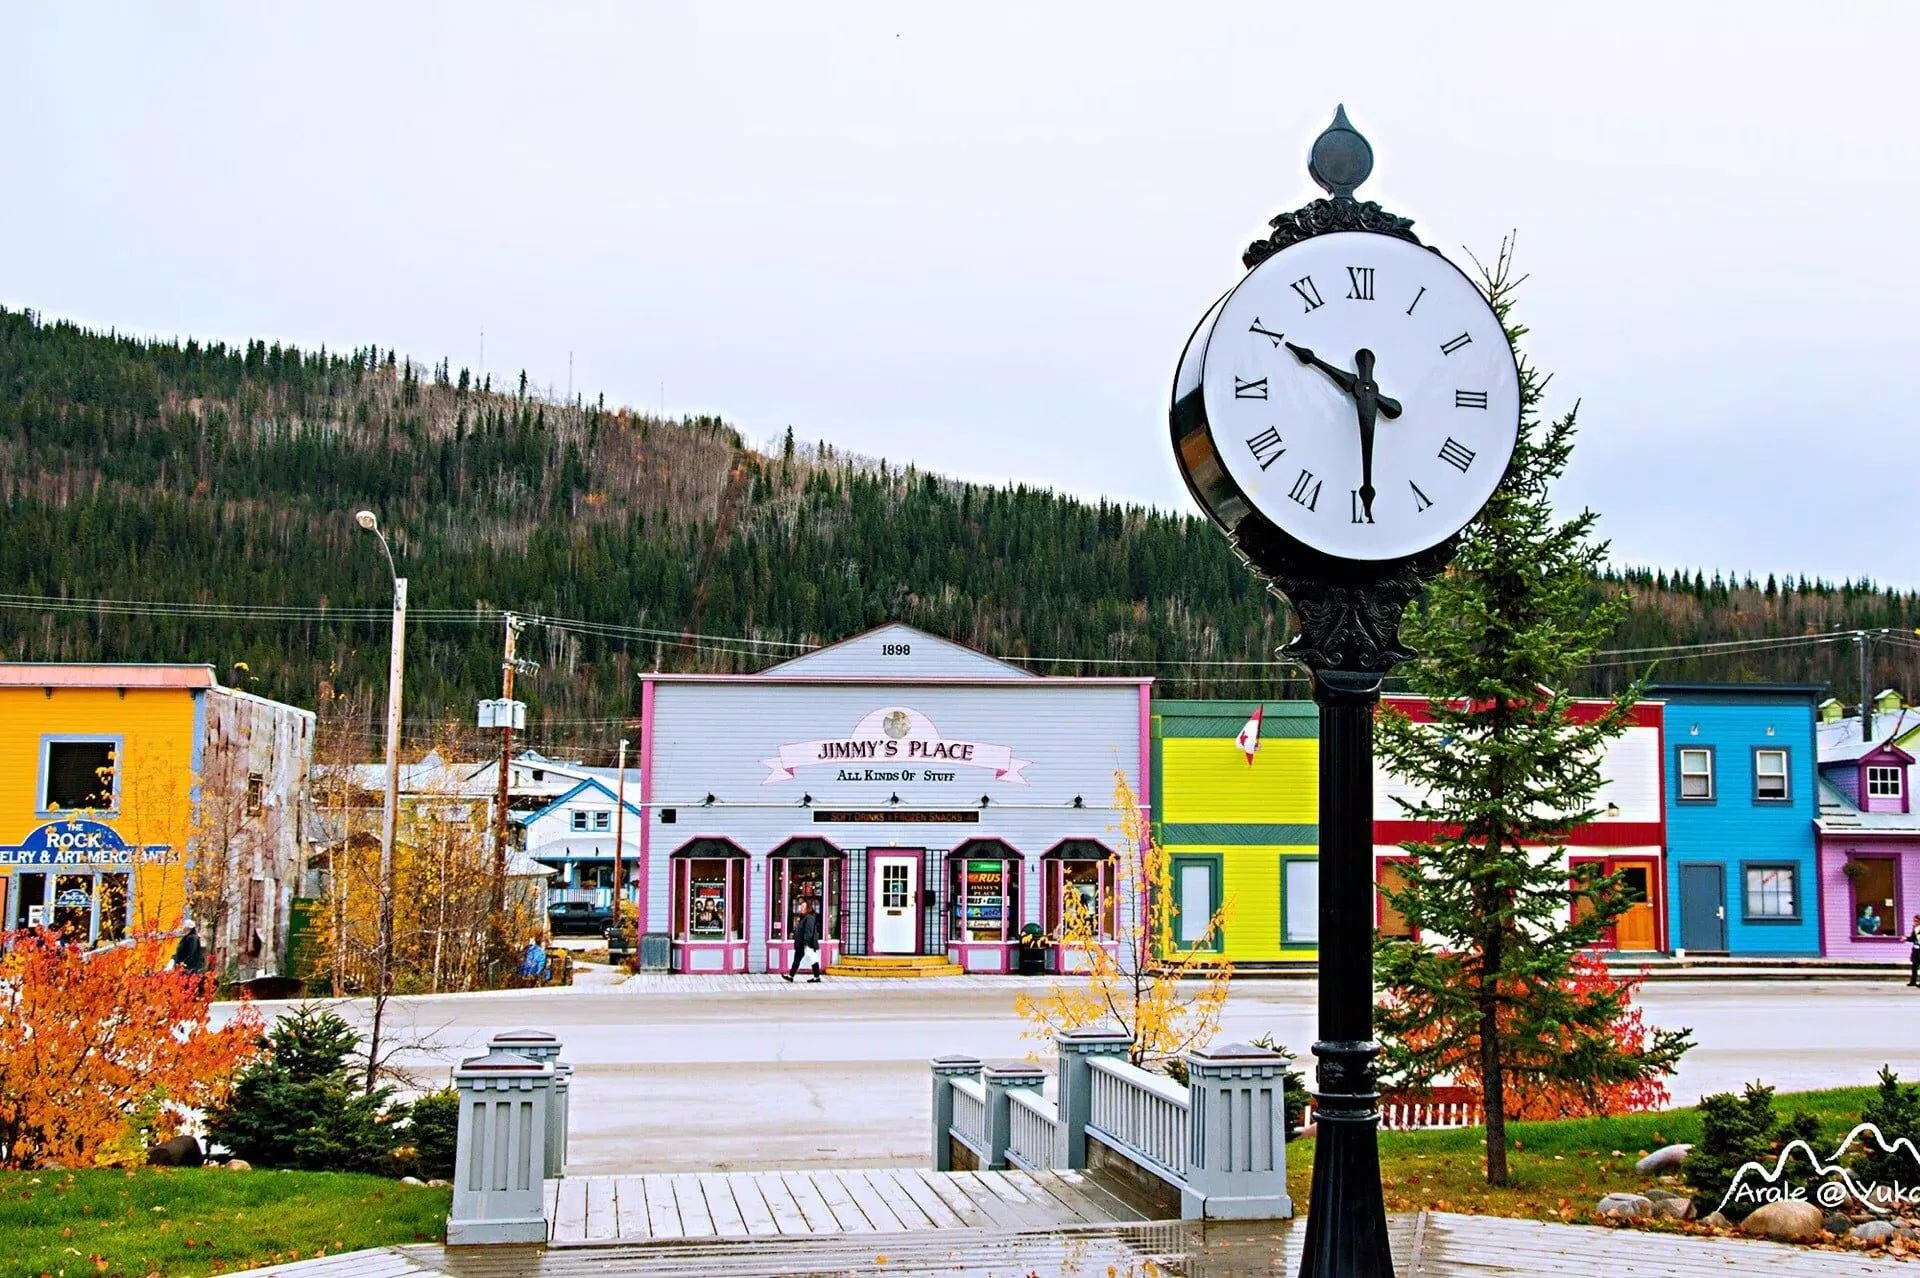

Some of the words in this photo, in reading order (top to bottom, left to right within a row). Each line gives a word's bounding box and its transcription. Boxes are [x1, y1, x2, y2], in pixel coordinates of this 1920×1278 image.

[1290, 276, 1325, 313] XI
[1346, 267, 1375, 300] XII
[1406, 287, 1426, 315] I
[1249, 317, 1284, 348] X
[1440, 332, 1472, 356] II
[1235, 376, 1267, 400] IX
[1455, 389, 1487, 410] III
[1246, 426, 1286, 471] VIII
[1438, 437, 1476, 473] IIII
[1288, 469, 1322, 512] VII
[1409, 480, 1433, 512] V
[882, 644, 911, 656] 1898
[818, 740, 898, 760] JIMMY'S
[908, 741, 974, 761] PLACE
[836, 770, 862, 782] ALL
[864, 770, 899, 782] KINDS
[924, 770, 955, 782] STUFF
[855, 813, 885, 821] DRINKS
[895, 813, 927, 821] FROZEN
[929, 813, 962, 821] SNACKS
[46, 833, 101, 848] ROCK
[40, 850, 51, 863] &
[54, 851, 84, 863] ART
[88, 850, 180, 864] MERCANTS
